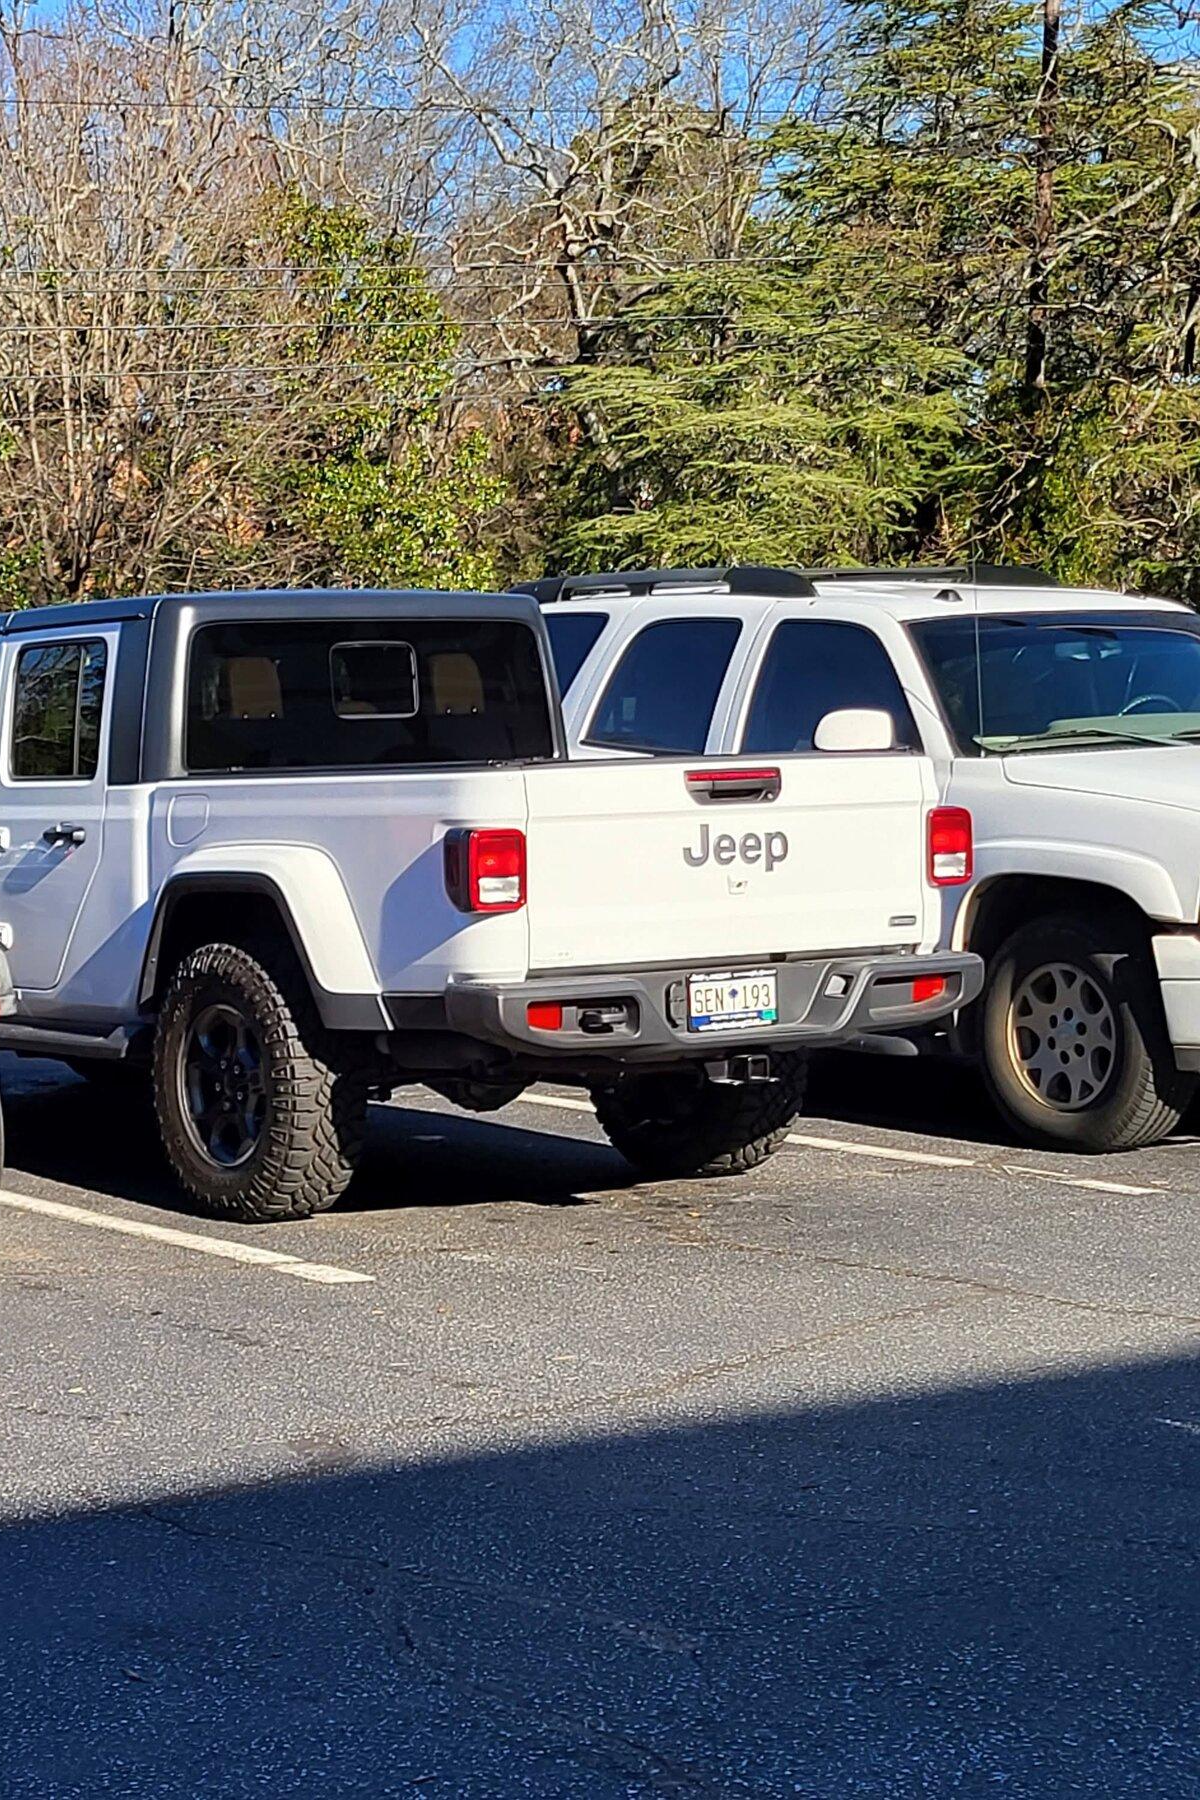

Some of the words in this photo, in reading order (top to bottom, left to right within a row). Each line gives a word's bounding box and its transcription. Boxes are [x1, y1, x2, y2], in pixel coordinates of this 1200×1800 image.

[682, 823, 789, 873] Jeep
[694, 987, 725, 1014] SEN
[742, 983, 771, 1009] 193
